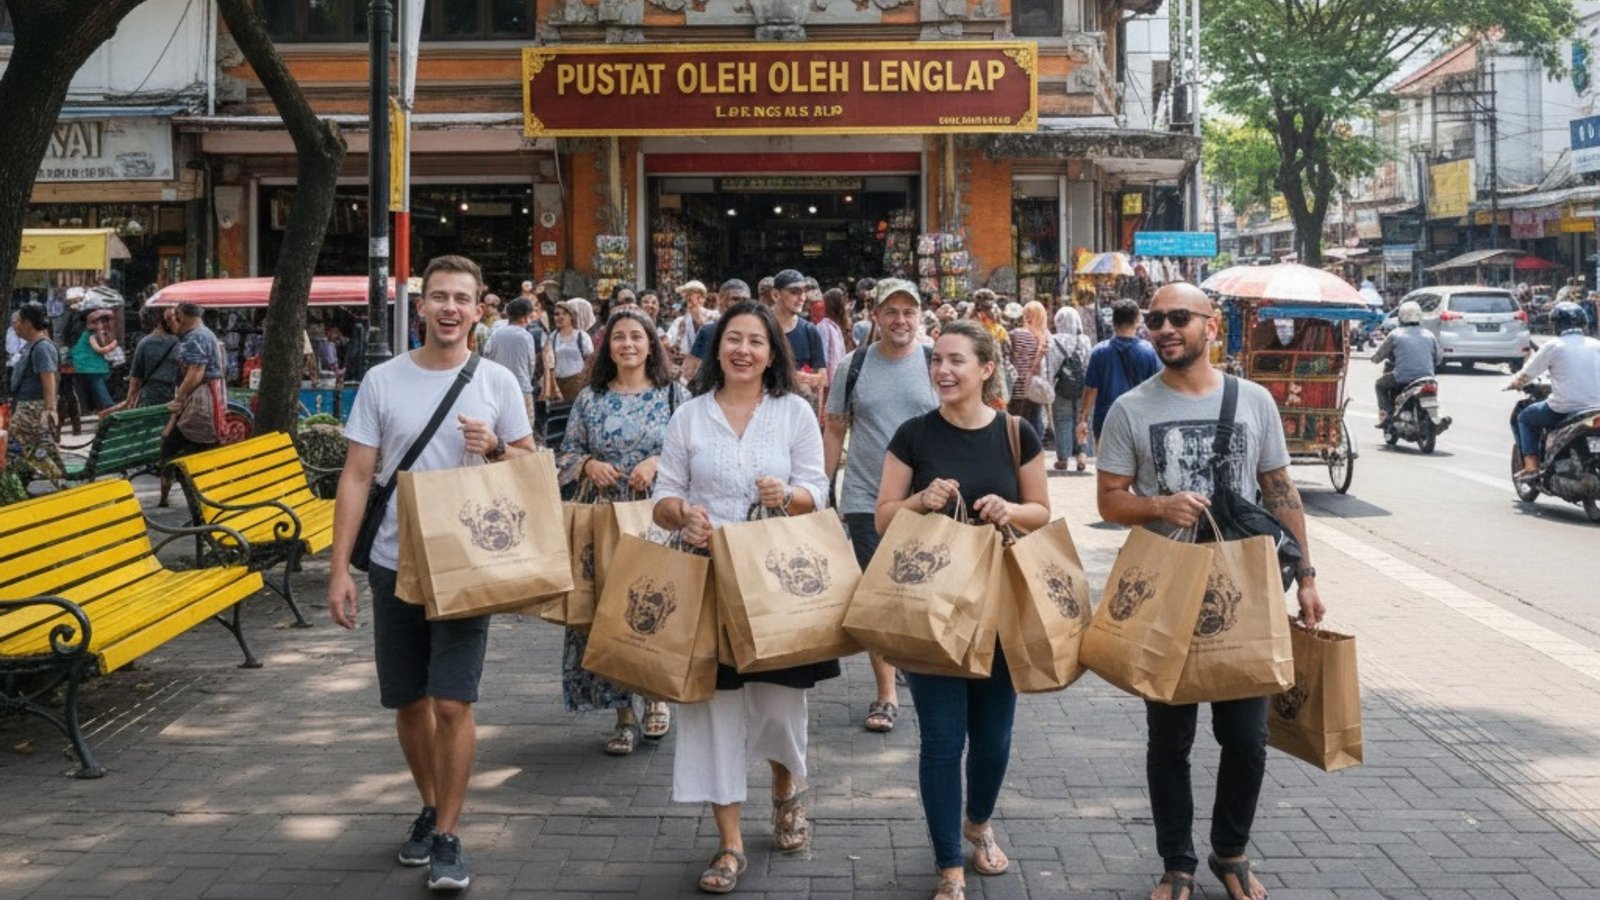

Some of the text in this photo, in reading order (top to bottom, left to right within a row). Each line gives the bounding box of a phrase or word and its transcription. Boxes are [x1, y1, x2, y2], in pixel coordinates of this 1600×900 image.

[557, 60, 1006, 95] PUSTAT OLEH OLEH LENGLAP
